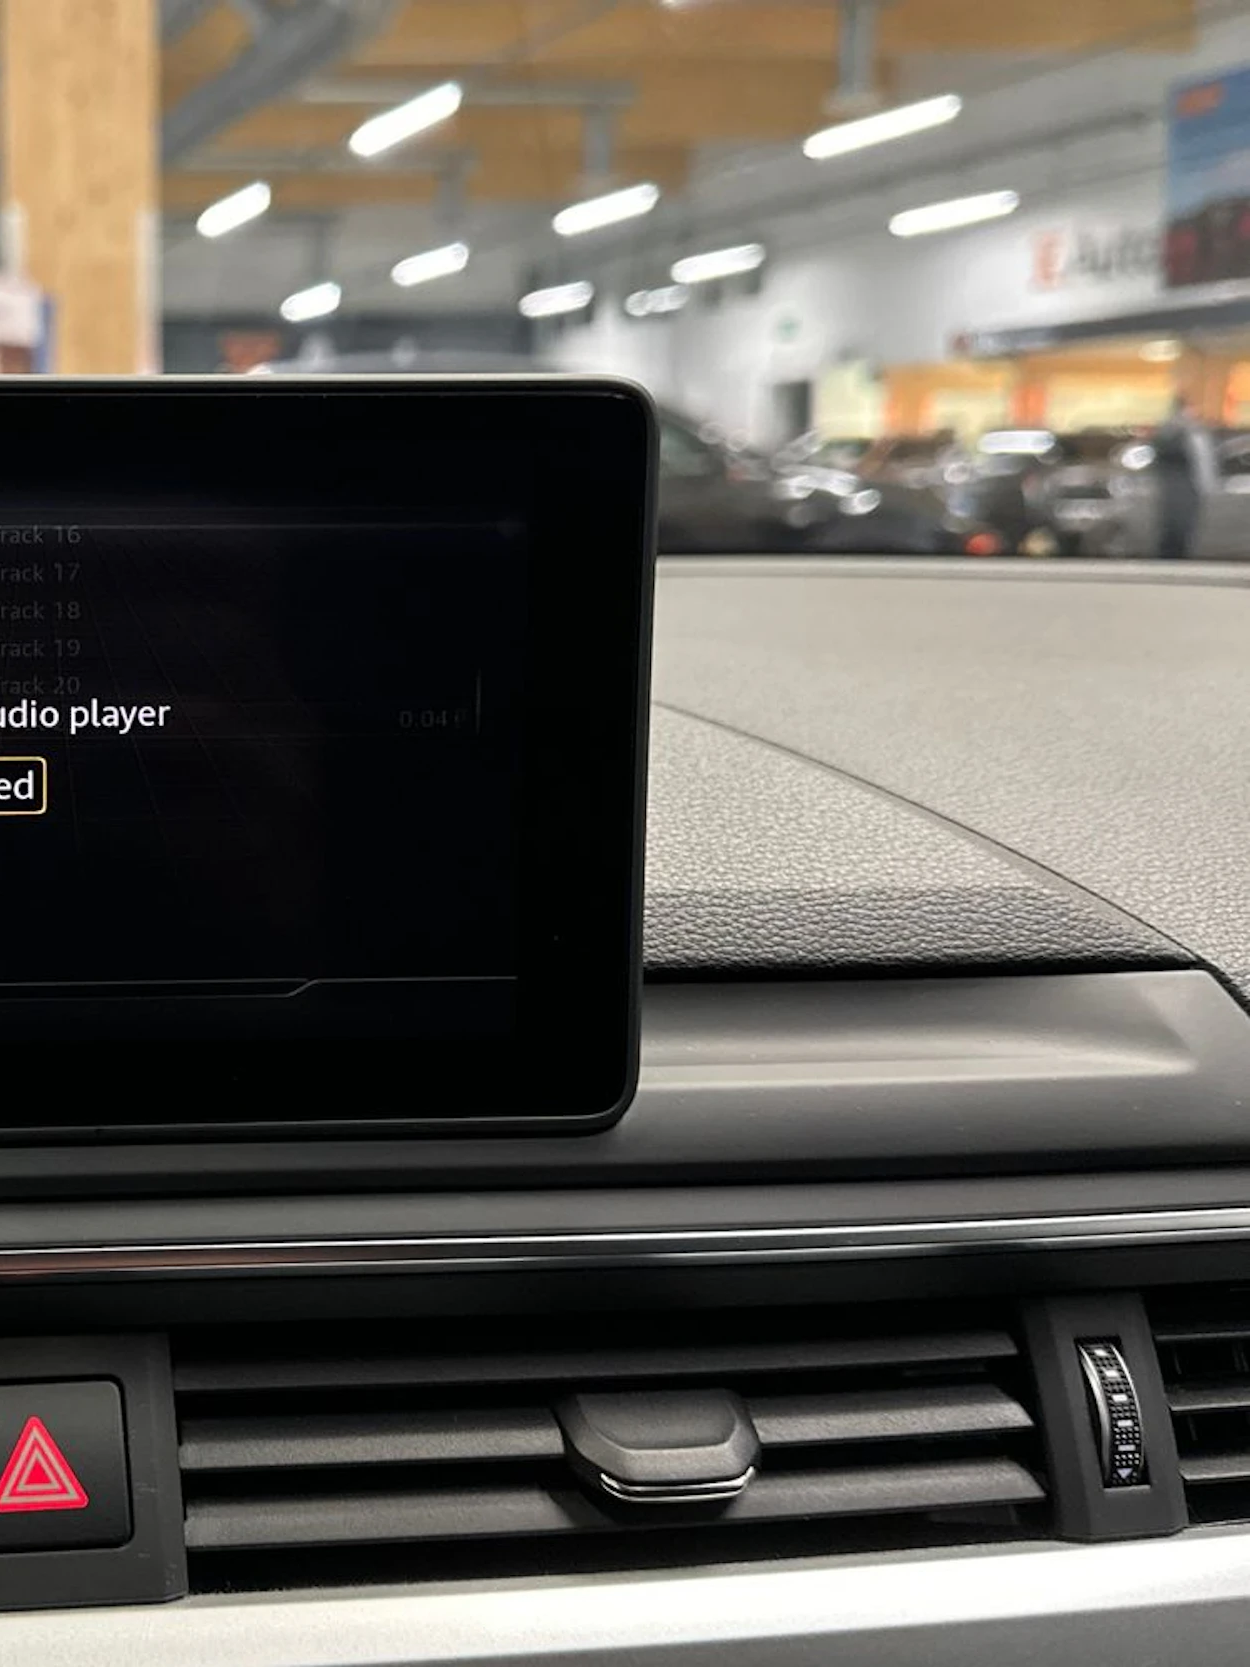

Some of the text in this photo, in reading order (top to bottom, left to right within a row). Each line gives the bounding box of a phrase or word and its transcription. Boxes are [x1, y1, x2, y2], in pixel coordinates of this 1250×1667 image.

[54, 525, 82, 544] 16
[54, 562, 81, 582] 17
[55, 600, 81, 620] 18
[54, 638, 81, 658] 19
[53, 675, 81, 695] 20
[70, 698, 171, 736] player
